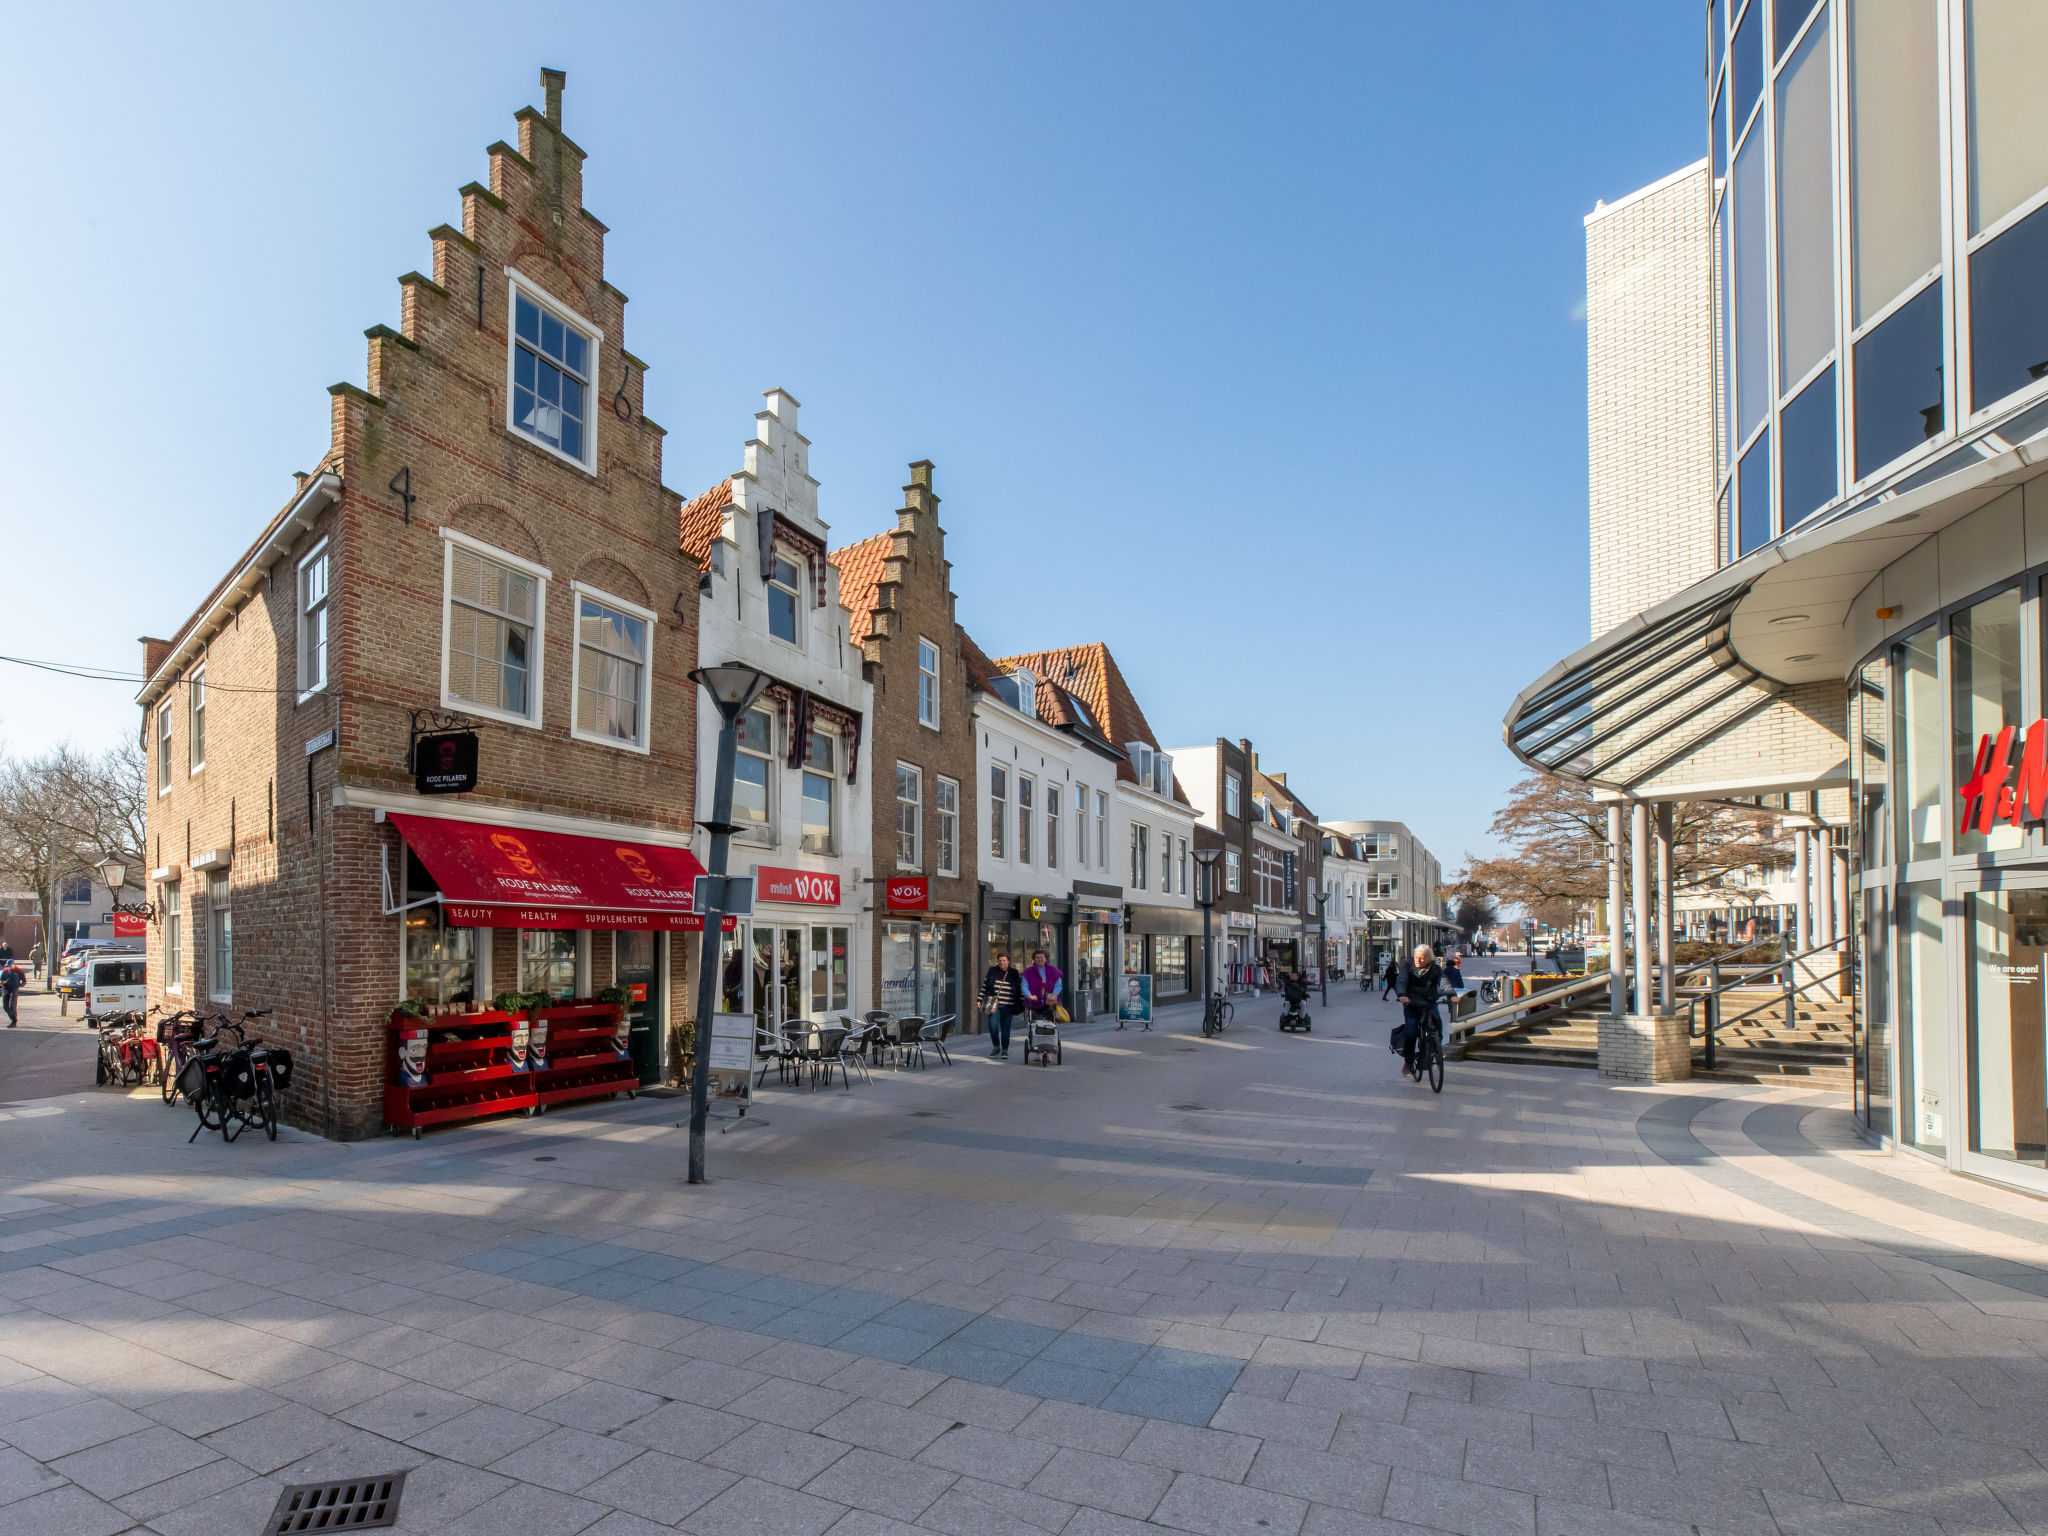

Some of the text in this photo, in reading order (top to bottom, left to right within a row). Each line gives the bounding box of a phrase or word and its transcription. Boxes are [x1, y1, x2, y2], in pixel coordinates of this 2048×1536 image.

[442, 774, 467, 782] PILAREN
[496, 877, 583, 894] RODE PILAREN
[770, 875, 835, 902] mini WOK
[892, 886, 922, 897] WOK
[624, 887, 693, 899] RODE PILAREN
[452, 908, 733, 926] BEAUTY HEALTH SUPPLEMENTEN KRUIDEN HEE
[2016, 964, 2039, 975] open!
